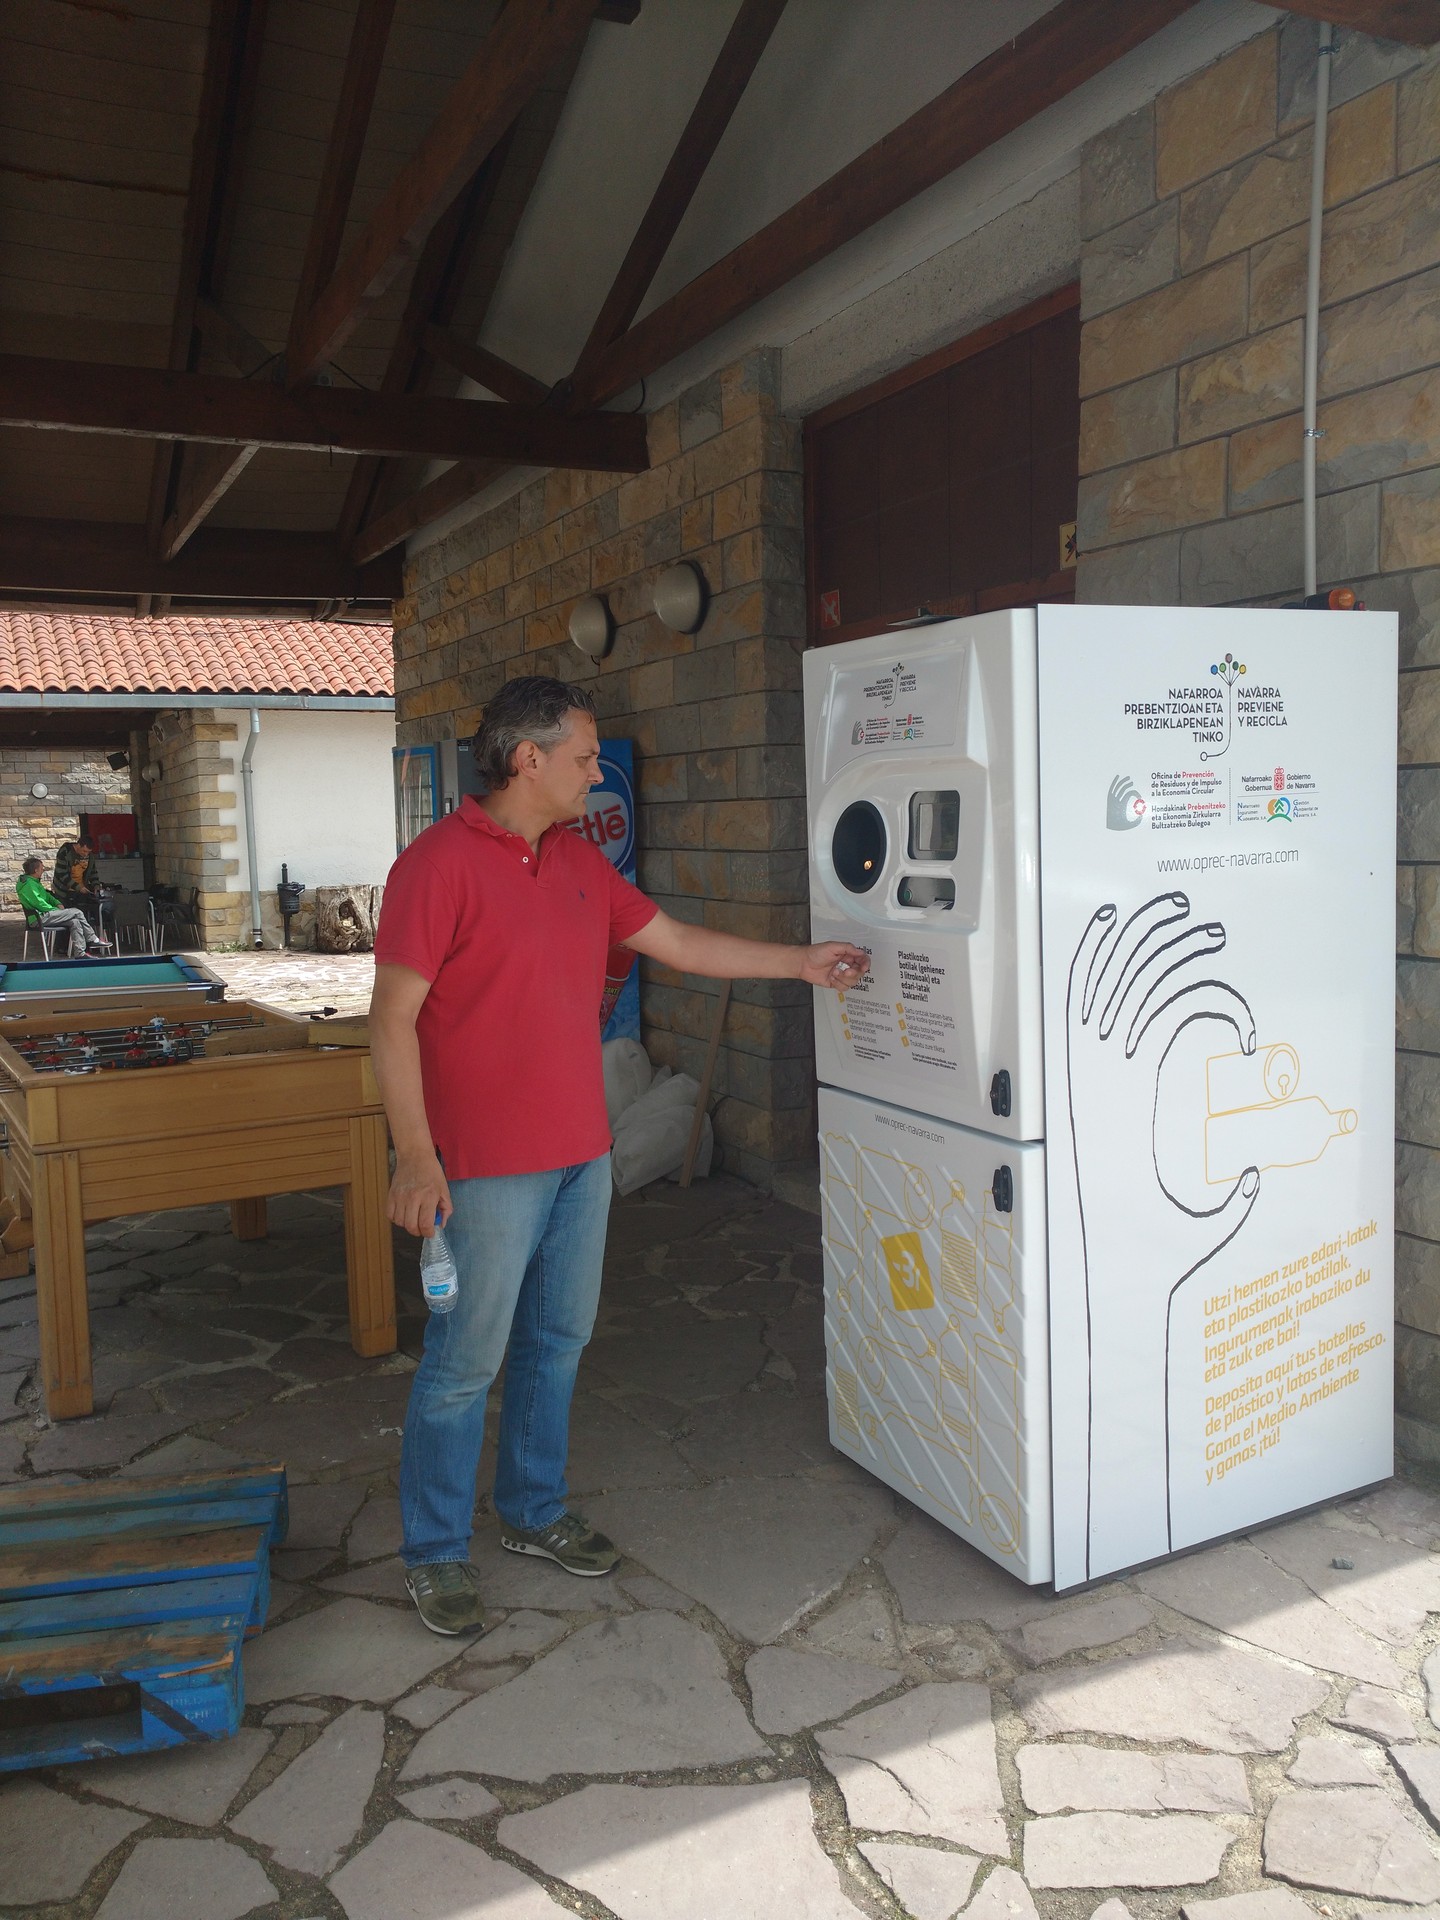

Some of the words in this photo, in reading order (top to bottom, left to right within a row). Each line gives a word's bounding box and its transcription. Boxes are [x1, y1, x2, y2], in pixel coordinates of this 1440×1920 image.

[1168, 687, 1224, 700] NAFARROA
[1124, 702, 1204, 715] PREBENTZIOAN
[1205, 702, 1224, 714] ETA
[1237, 701, 1284, 713] PREVIENE
[1137, 716, 1224, 730] BIRZIKLAPENEAN
[1237, 716, 1245, 728] Y
[1246, 715, 1288, 727] RECICLA
[1192, 731, 1224, 743] TINKO
[1151, 772, 1173, 780] Oficina
[1173, 771, 1181, 779] de
[1182, 770, 1215, 778] Prevención
[1241, 775, 1273, 783] Nafarroako
[1286, 773, 1312, 781] Gobierno
[1151, 781, 1159, 789] de
[1160, 780, 1186, 788] Residuos
[1191, 779, 1199, 787] de
[1200, 778, 1222, 788] Impulso
[1244, 784, 1273, 792] Gobernua
[1155, 789, 1161, 797] la
[1162, 787, 1190, 796] Economía
[1191, 786, 1215, 795] Circular
[1151, 804, 1187, 813] Hondakinak
[1162, 812, 1192, 821] Ekonomia
[1192, 811, 1221, 819] Zirkularra
[1151, 821, 1187, 830] Bultzatzeko
[1187, 819, 1211, 828] Bulegoa
[1157, 848, 1299, 873] www.oprec-navarra.com
[898, 950, 930, 963] Plastikozko
[899, 960, 918, 971] botilak
[900, 970, 904, 979] 3
[931, 976, 941, 985] eta
[901, 981, 931, 993] edari-latak
[874, 1113, 945, 1144] www.oprec-navarra.com
[1204, 1287, 1231, 1317] Utzi
[1233, 1270, 1279, 1303] hemen
[1281, 1255, 1309, 1280] zure
[1311, 1218, 1378, 1265] edari-latak
[1204, 1319, 1226, 1339] eta
[1228, 1280, 1303, 1332] plastikozko
[1305, 1253, 1352, 1289] botilak.
[1204, 1304, 1293, 1363] Ingurumenak
[1295, 1278, 1353, 1318] irabaziko
[1355, 1267, 1371, 1288] du
[1204, 1362, 1226, 1384] eta
[1229, 1345, 1253, 1372] zuk
[1255, 1337, 1275, 1358] ere
[1277, 1319, 1300, 1347] bai!
[1205, 1375, 1263, 1417] Deposita
[1265, 1353, 1294, 1383] aquí
[1295, 1347, 1316, 1368] tus
[1318, 1320, 1366, 1357] botellas
[1205, 1416, 1222, 1438] de
[1224, 1390, 1274, 1432] plástico
[1276, 1384, 1284, 1403] y
[1287, 1367, 1317, 1394] latas
[1320, 1356, 1335, 1376] de
[1337, 1332, 1386, 1368] refresco.
[1205, 1432, 1241, 1461] Gana
[1243, 1420, 1254, 1442] el
[1257, 1402, 1297, 1435] Medio
[1299, 1368, 1360, 1412] Ambiente
[1205, 1466, 1214, 1486] y
[1216, 1443, 1257, 1480] ganas
[1259, 1425, 1281, 1457] ¡tú!
